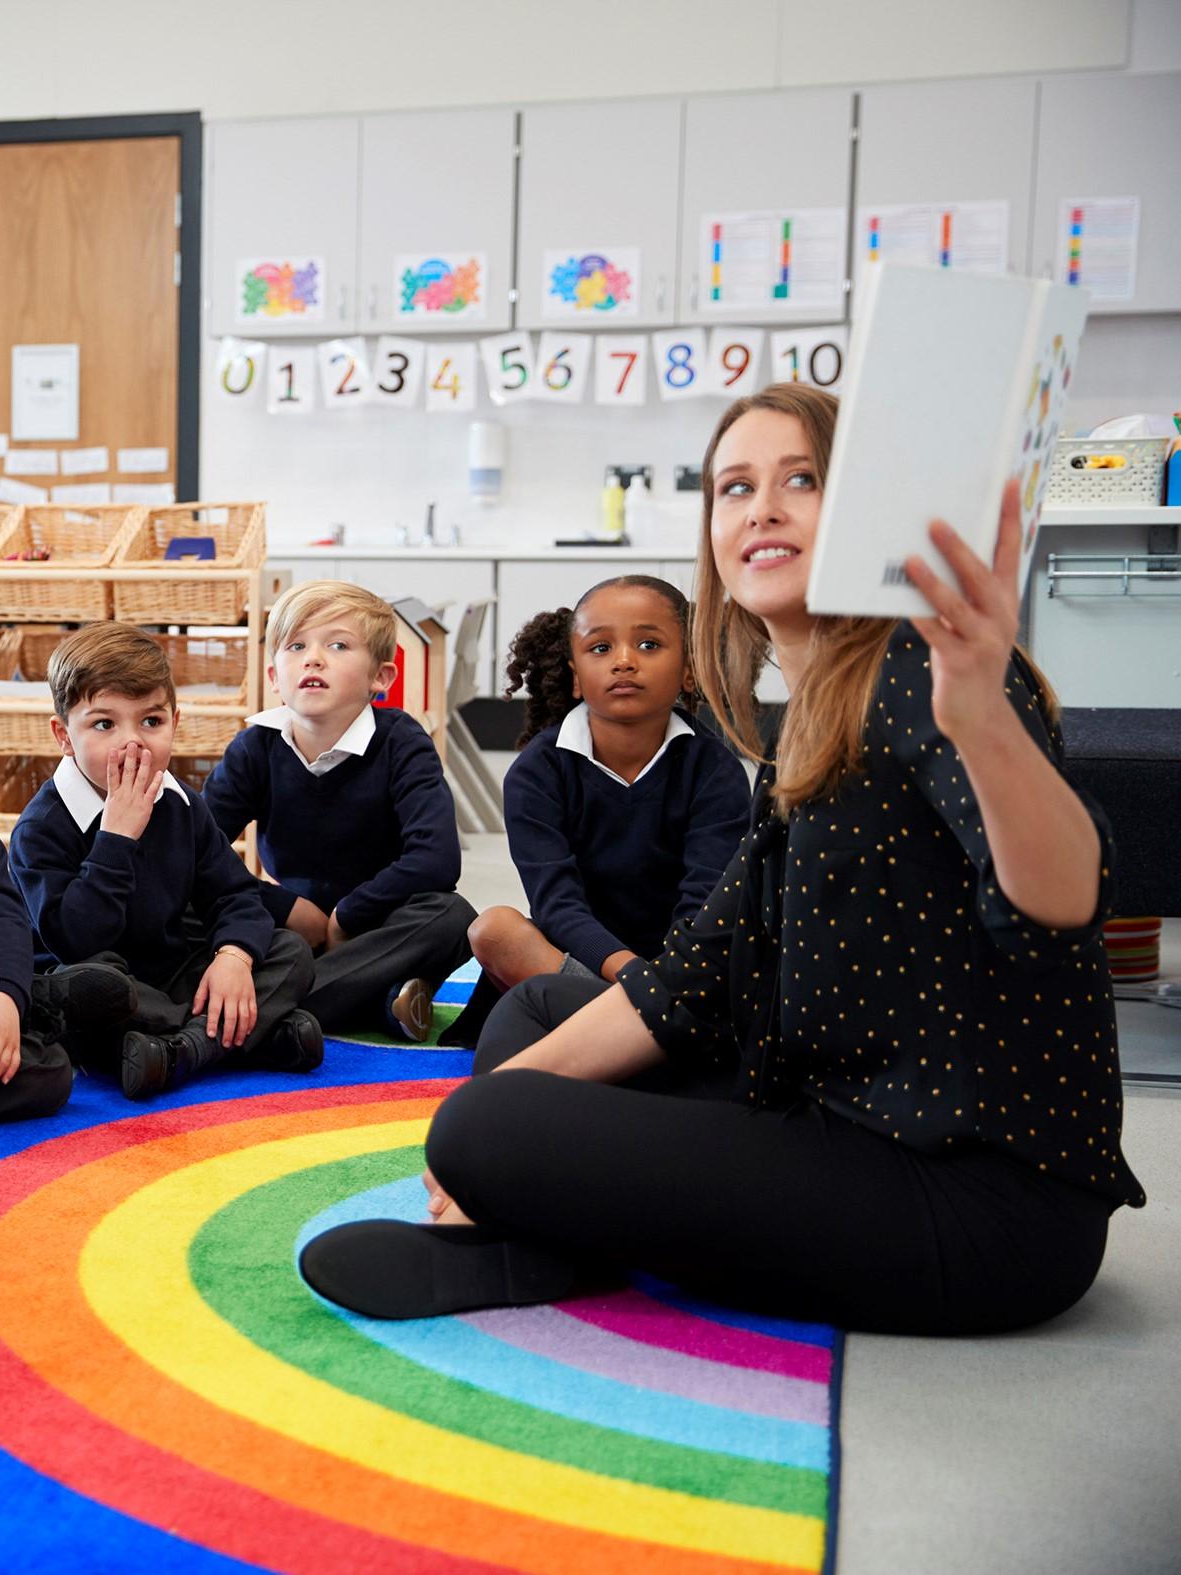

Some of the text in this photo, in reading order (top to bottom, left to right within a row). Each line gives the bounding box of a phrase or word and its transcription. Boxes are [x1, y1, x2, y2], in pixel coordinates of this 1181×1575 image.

[278, 362, 300, 402] 1
[329, 353, 360, 395] 2
[378, 352, 409, 393] 3
[431, 358, 462, 400] 4
[500, 346, 528, 390] 5
[544, 346, 572, 390] 6
[609, 352, 638, 394] 7
[665, 343, 694, 388] 8
[721, 343, 750, 386] 9
[782, 342, 843, 387] 10
